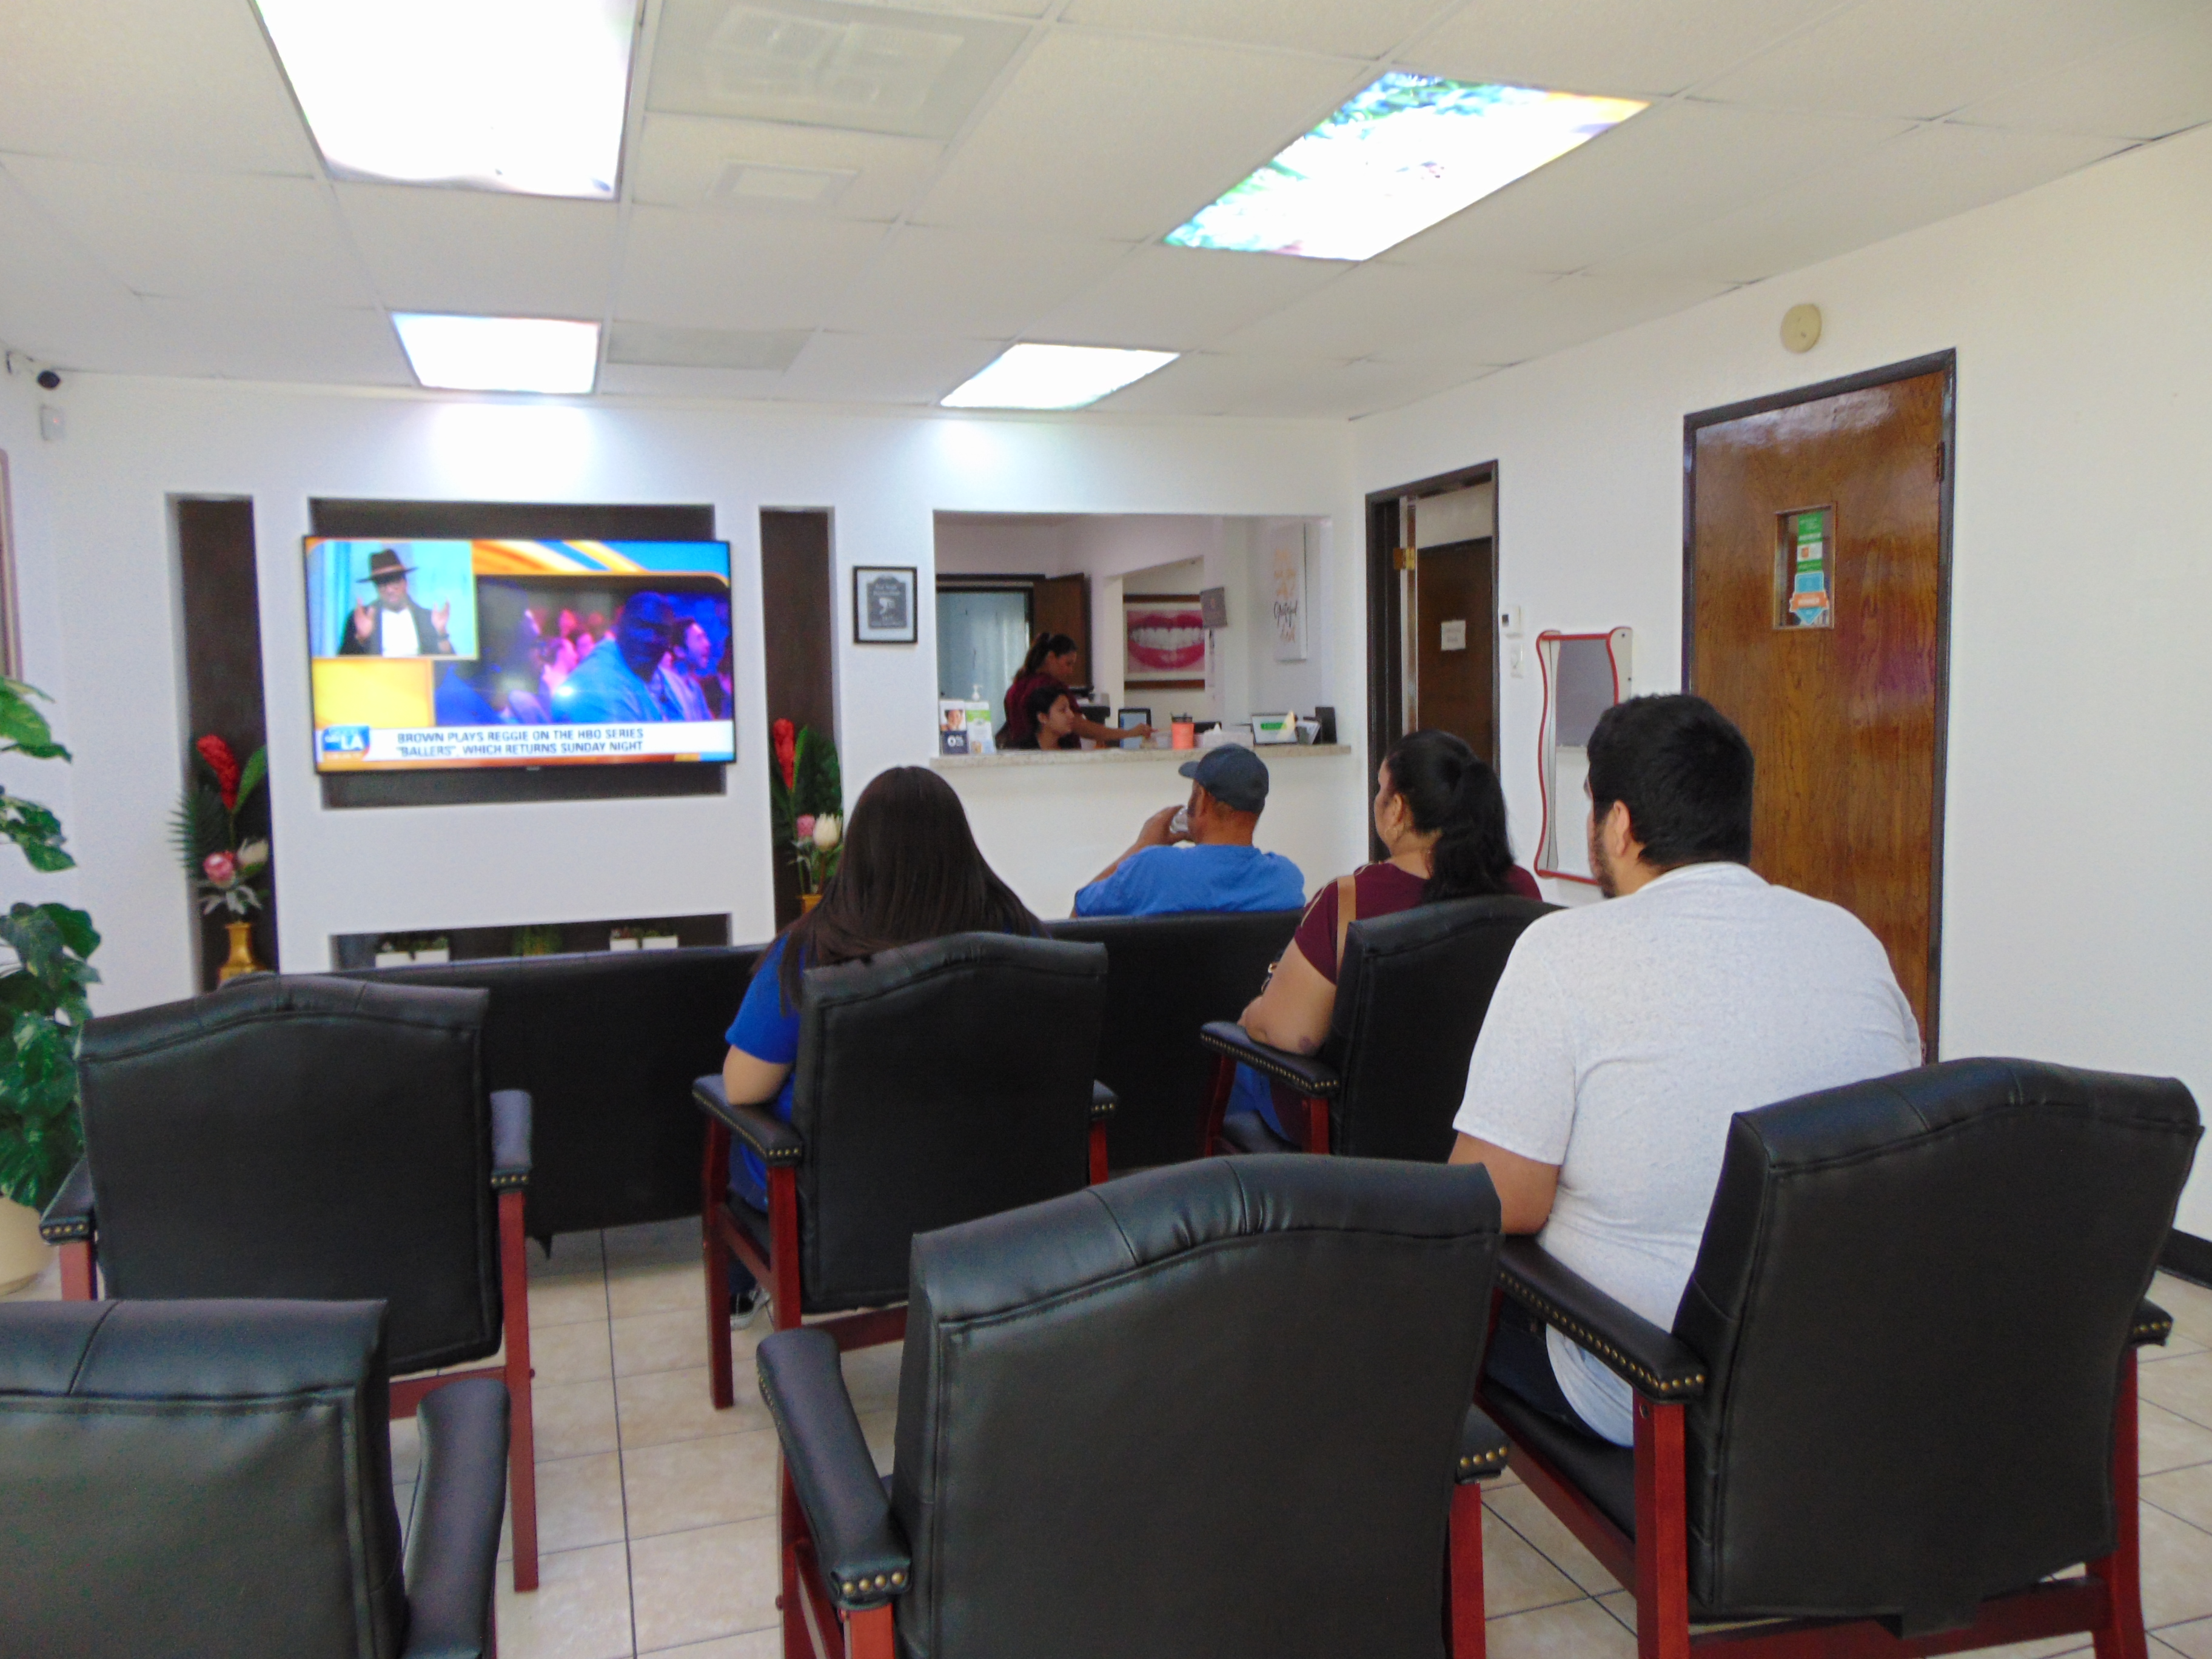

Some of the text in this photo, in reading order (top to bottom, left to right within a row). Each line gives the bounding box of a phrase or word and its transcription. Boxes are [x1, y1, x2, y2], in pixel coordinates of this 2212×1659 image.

[397, 728, 643, 743] BROWN PLAYS REGGIE ON THE HBO SERIES
[463, 745, 501, 755] WHICH
[505, 743, 557, 756] RETURNS
[560, 742, 606, 752] SUNDAY
[609, 741, 643, 752] NIGHT
